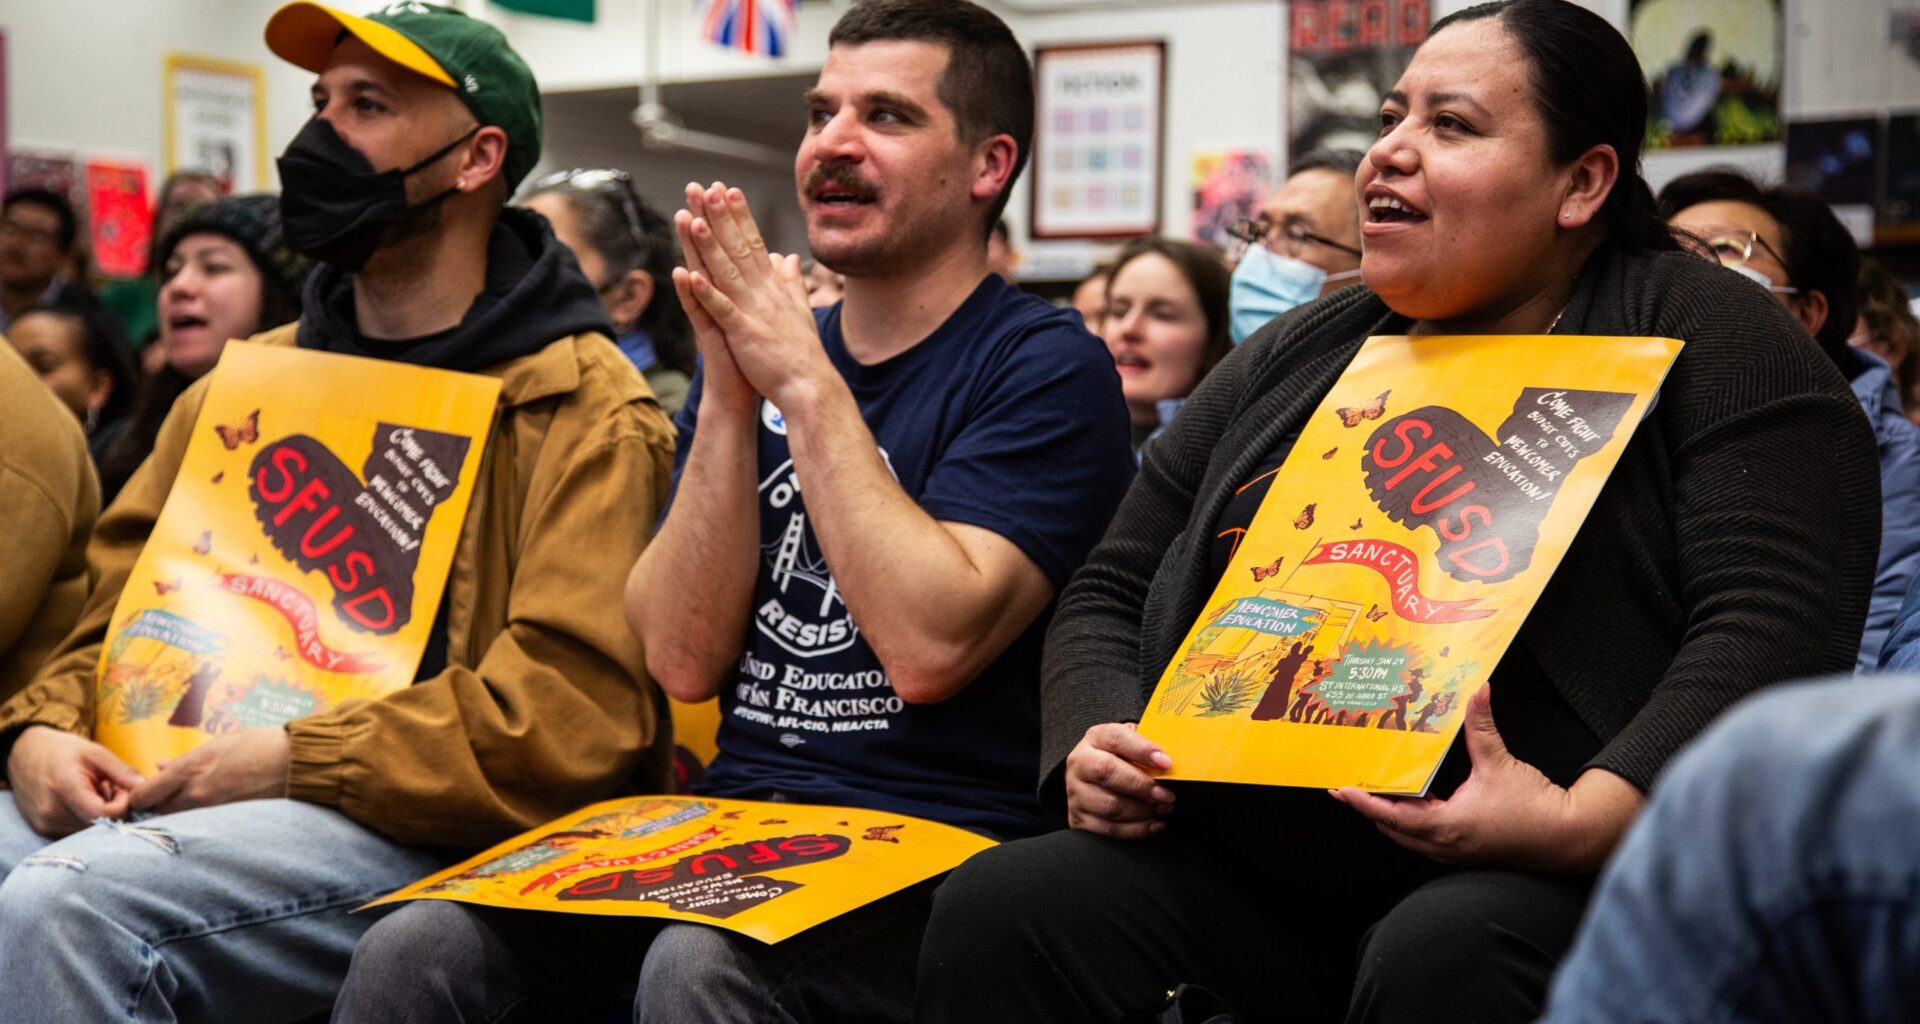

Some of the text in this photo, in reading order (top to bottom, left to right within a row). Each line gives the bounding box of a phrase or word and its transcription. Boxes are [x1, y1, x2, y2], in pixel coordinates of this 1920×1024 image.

[1290, 0, 1429, 49] READ
[1526, 410, 1580, 459] BUDGET CUTS
[1536, 391, 1601, 442] COME FIGHT
[389, 428, 451, 488] COME FIGHT
[1503, 435, 1561, 481] NEWCOMER
[1535, 438, 1549, 449] TO
[1372, 418, 1510, 577] SFUSD
[1482, 451, 1552, 503] EDUCATION!
[354, 491, 420, 553] EDUCATION!
[368, 474, 424, 531] NEWCOMER
[256, 447, 395, 630] SFUSD
[1329, 542, 1444, 620] SANCTUARY
[230, 574, 345, 669] SANCTUARY
[1219, 614, 1297, 633] EDUCATION
[1233, 600, 1300, 620] NEWCOMER
[774, 687, 903, 717] FRANCISCO
[780, 664, 893, 691] EDUCATO
[1334, 681, 1390, 692] INTERNATIONAL
[777, 716, 829, 733] AFL-CIO,
[832, 719, 889, 732] NEA/CTA
[554, 832, 715, 879] SANCTUARY
[568, 835, 840, 896] SFUSD
[735, 887, 783, 900] COME
